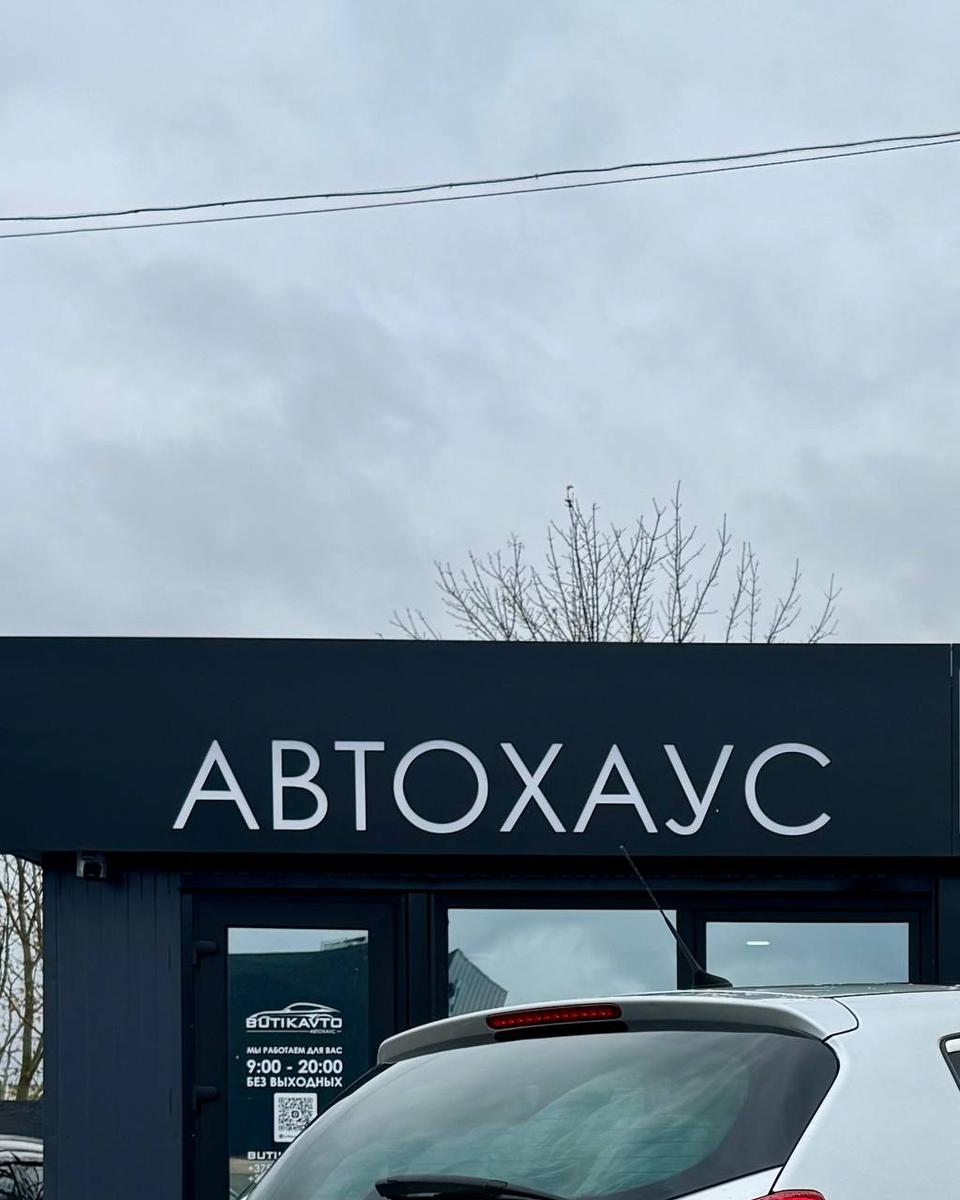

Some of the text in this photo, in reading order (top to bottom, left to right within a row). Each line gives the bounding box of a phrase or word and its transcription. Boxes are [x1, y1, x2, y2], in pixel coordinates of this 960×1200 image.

[172, 739, 832, 836] АВТОХАУС
[245, 1016, 343, 1029] BUTIKAVTO
[246, 1046, 343, 1056] МЫ РАБОТАЕМ ДЛЯ ВАС
[246, 1059, 282, 1074] 9:00
[297, 1059, 343, 1074] 20:00
[246, 1076, 344, 1089] БЕЗ ВЫХОДНЫХ
[247, 1151, 282, 1160] BUTI
